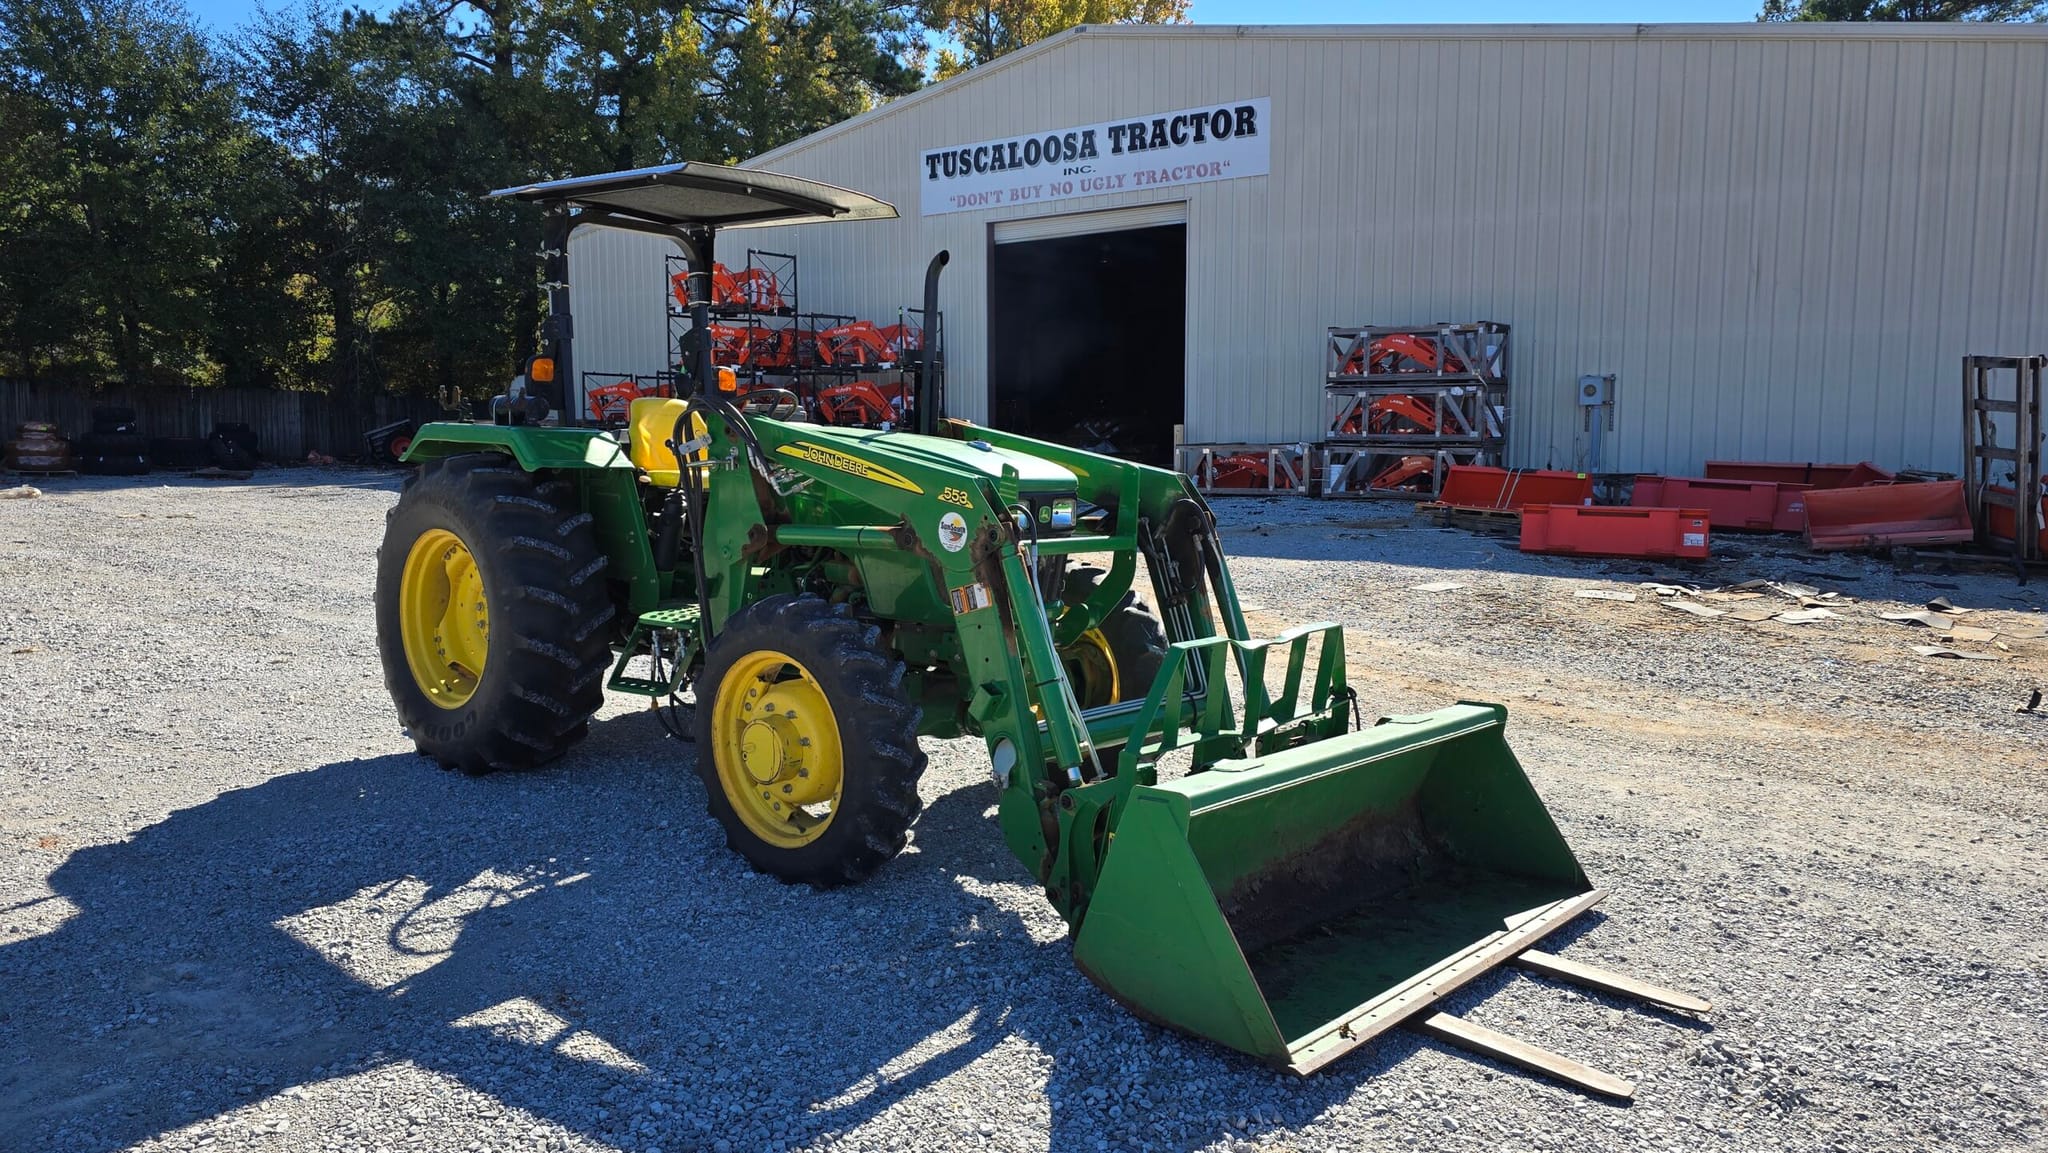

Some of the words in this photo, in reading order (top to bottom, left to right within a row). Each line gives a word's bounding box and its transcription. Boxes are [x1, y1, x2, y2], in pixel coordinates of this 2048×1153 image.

[925, 130, 1098, 180] TUSCALOOSA
[1108, 105, 1257, 155] TRACTOR
[1063, 165, 1096, 176] INC.
[1010, 185, 1043, 202] BUY
[1050, 182, 1074, 197] NO
[1080, 174, 1127, 193] UGLY
[803, 446, 834, 466] JOHN
[834, 454, 869, 476] DEERE
[944, 486, 968, 505] 553
